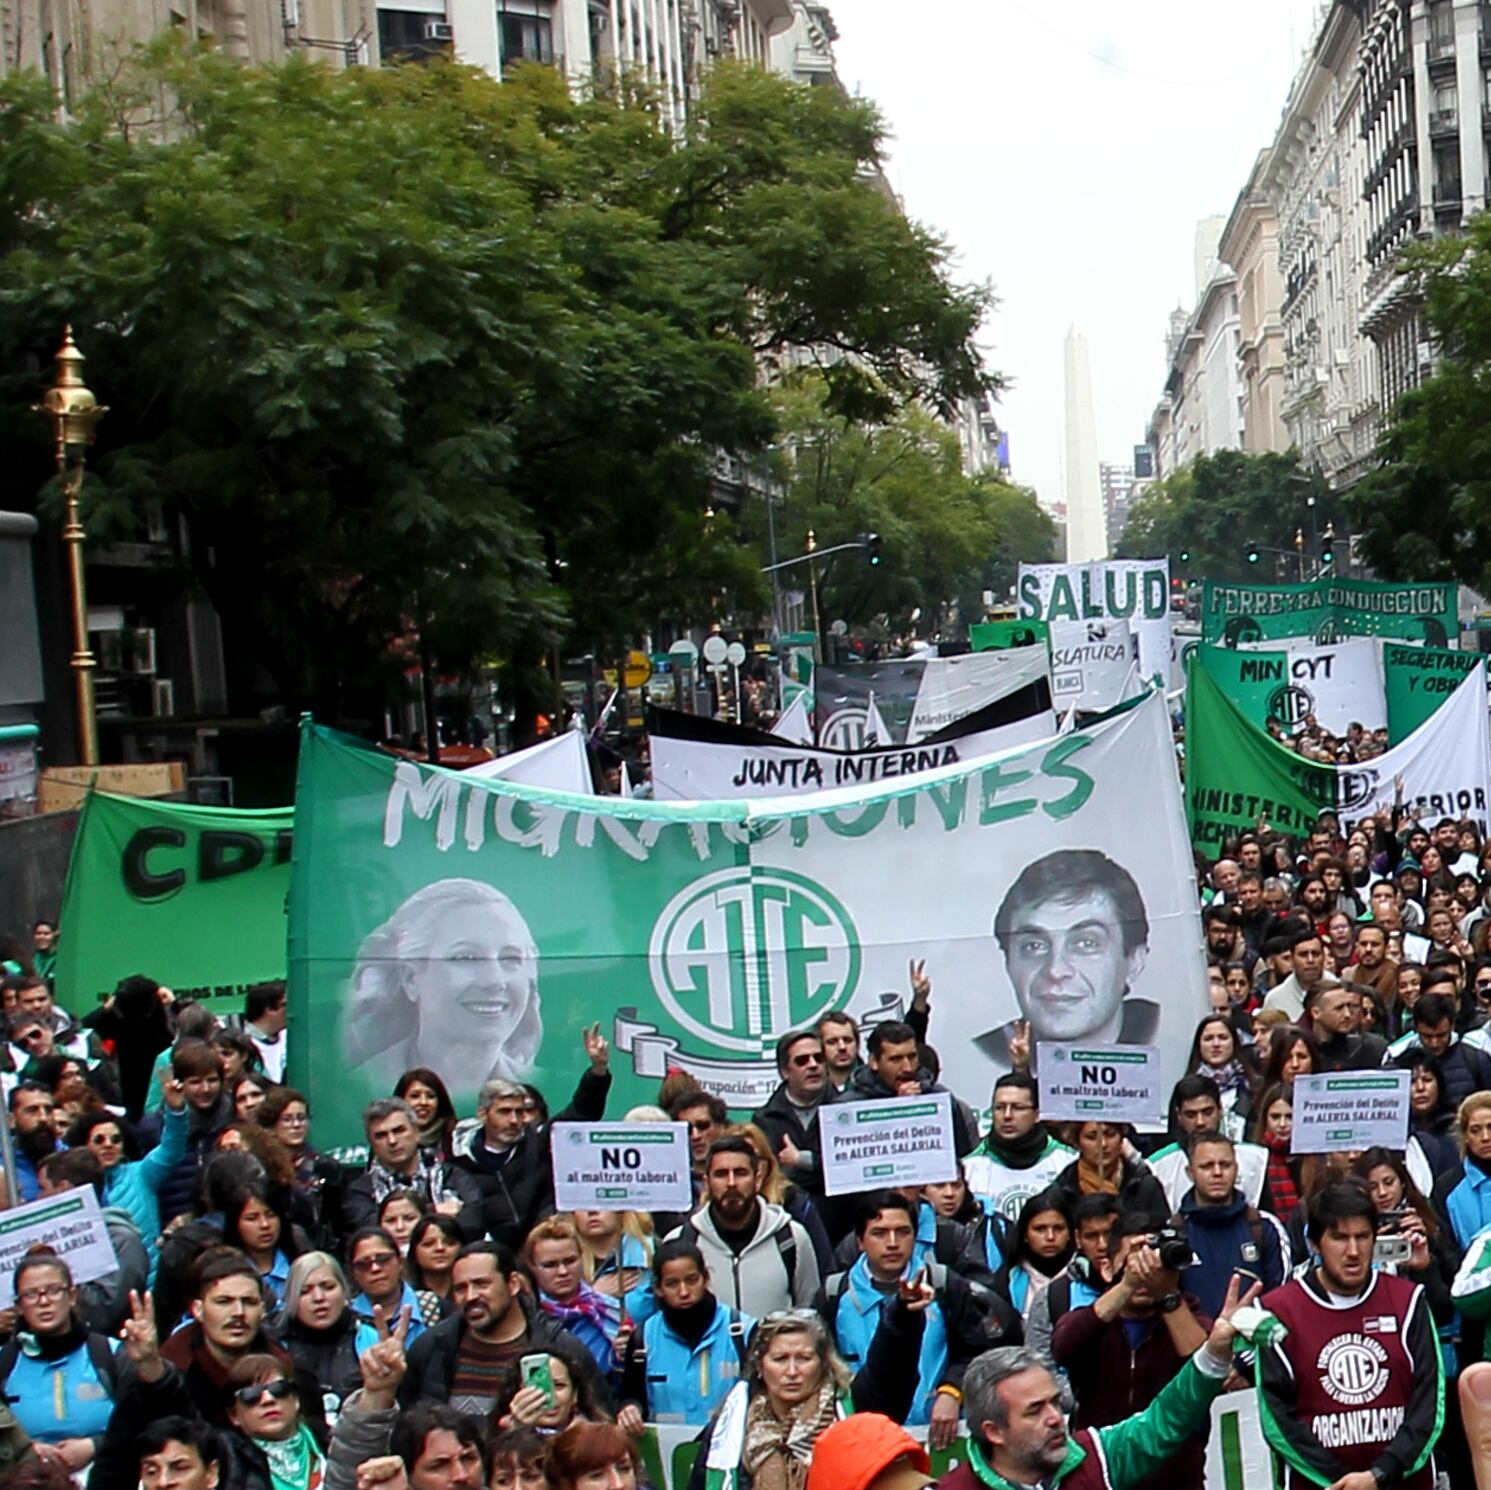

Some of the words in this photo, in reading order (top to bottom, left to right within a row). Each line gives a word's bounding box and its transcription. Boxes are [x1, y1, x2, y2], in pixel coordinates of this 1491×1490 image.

[1019, 570, 1167, 621] SALUD
[1210, 587, 1322, 615] FERREYRA
[1240, 659, 1282, 683] MIN
[1292, 654, 1336, 680] CYT
[733, 756, 825, 788] JUNTA
[834, 745, 960, 784] INTERNA
[664, 883, 840, 1036] ATE
[1081, 1066, 1117, 1085] NO
[1050, 1086, 1062, 1096] al
[1062, 1086, 1109, 1097] maltrato
[1111, 1087, 1149, 1098] laboral
[1316, 1112, 1350, 1123] ALERTA
[1352, 1111, 1398, 1121] SALARIAL
[833, 1130, 891, 1147] Prevención
[893, 1127, 909, 1140] del
[911, 1125, 942, 1138] Delito
[601, 1147, 642, 1169] NO
[835, 1151, 848, 1161] en
[849, 1145, 889, 1159] ALERTA
[890, 1139, 943, 1154] SALARIAL
[567, 1171, 578, 1183] al
[581, 1171, 633, 1183] maltrato
[635, 1171, 678, 1183] laboral
[1334, 1353, 1374, 1391] ATE
